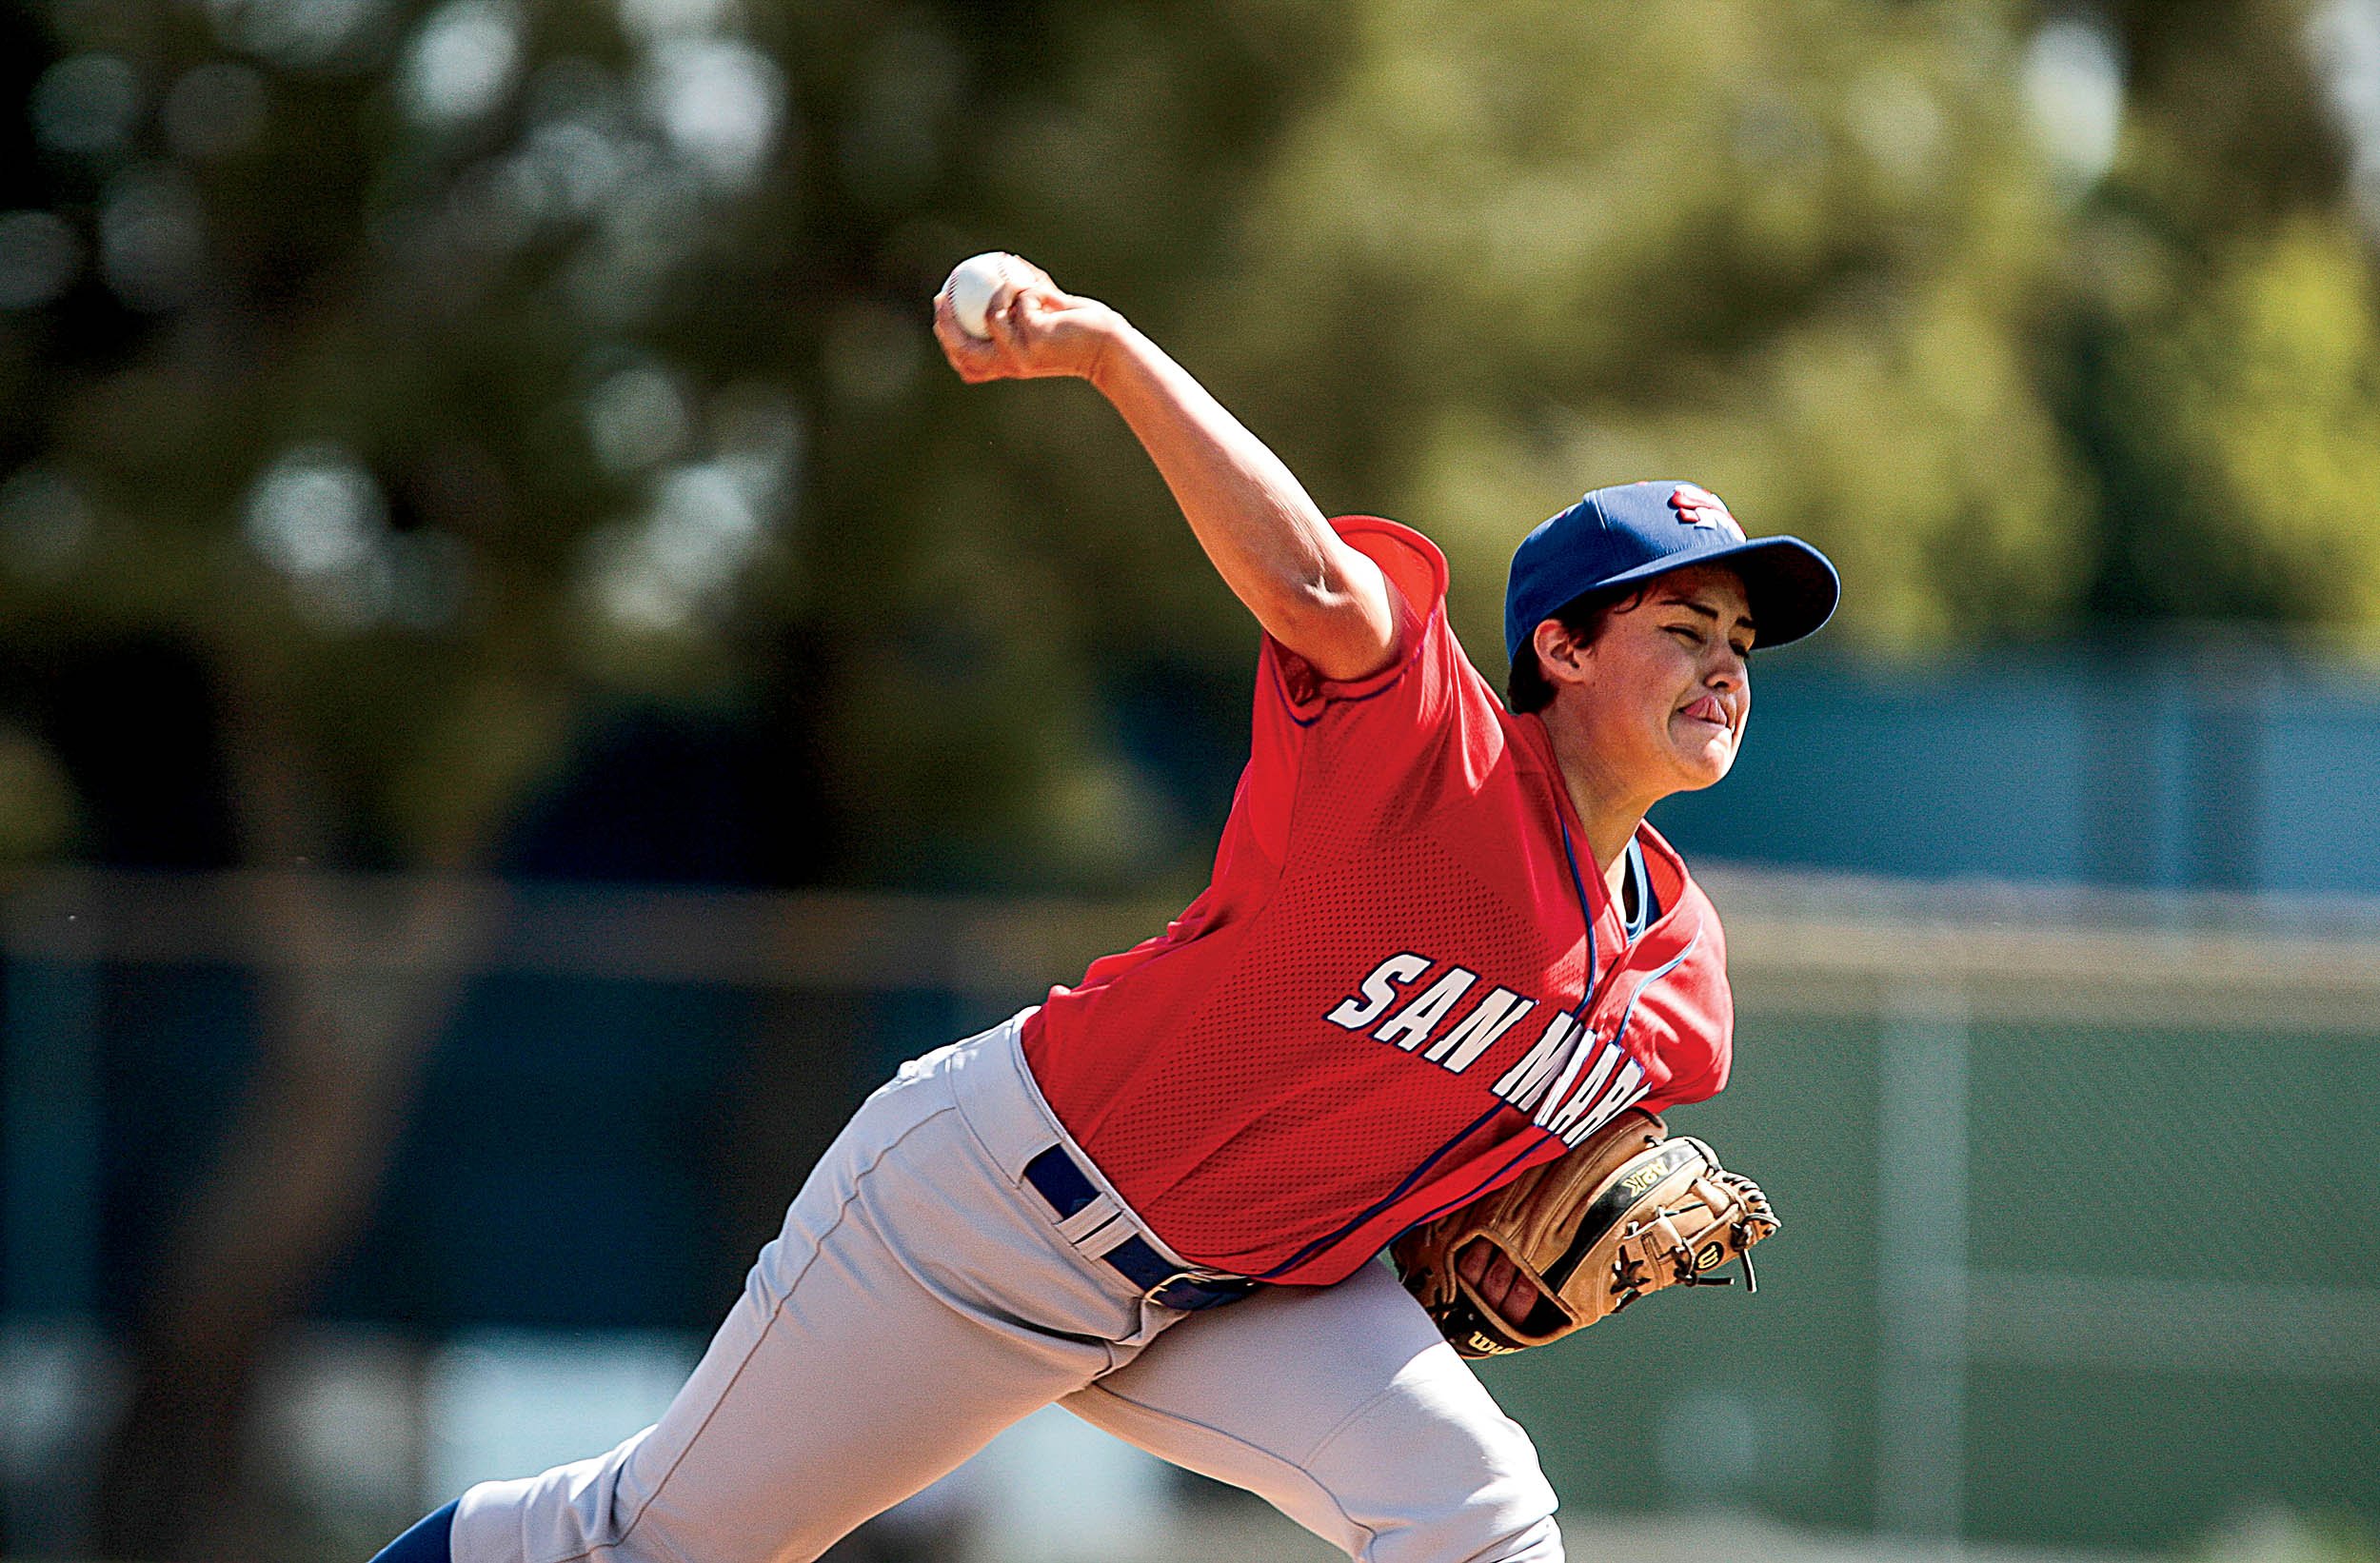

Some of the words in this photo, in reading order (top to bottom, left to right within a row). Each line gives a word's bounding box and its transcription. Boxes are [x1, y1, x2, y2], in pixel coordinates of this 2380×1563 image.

[1323, 952, 1539, 1075] SAN
[1490, 1009, 1653, 1151] MAR
[1621, 1157, 1670, 1197] A2K
